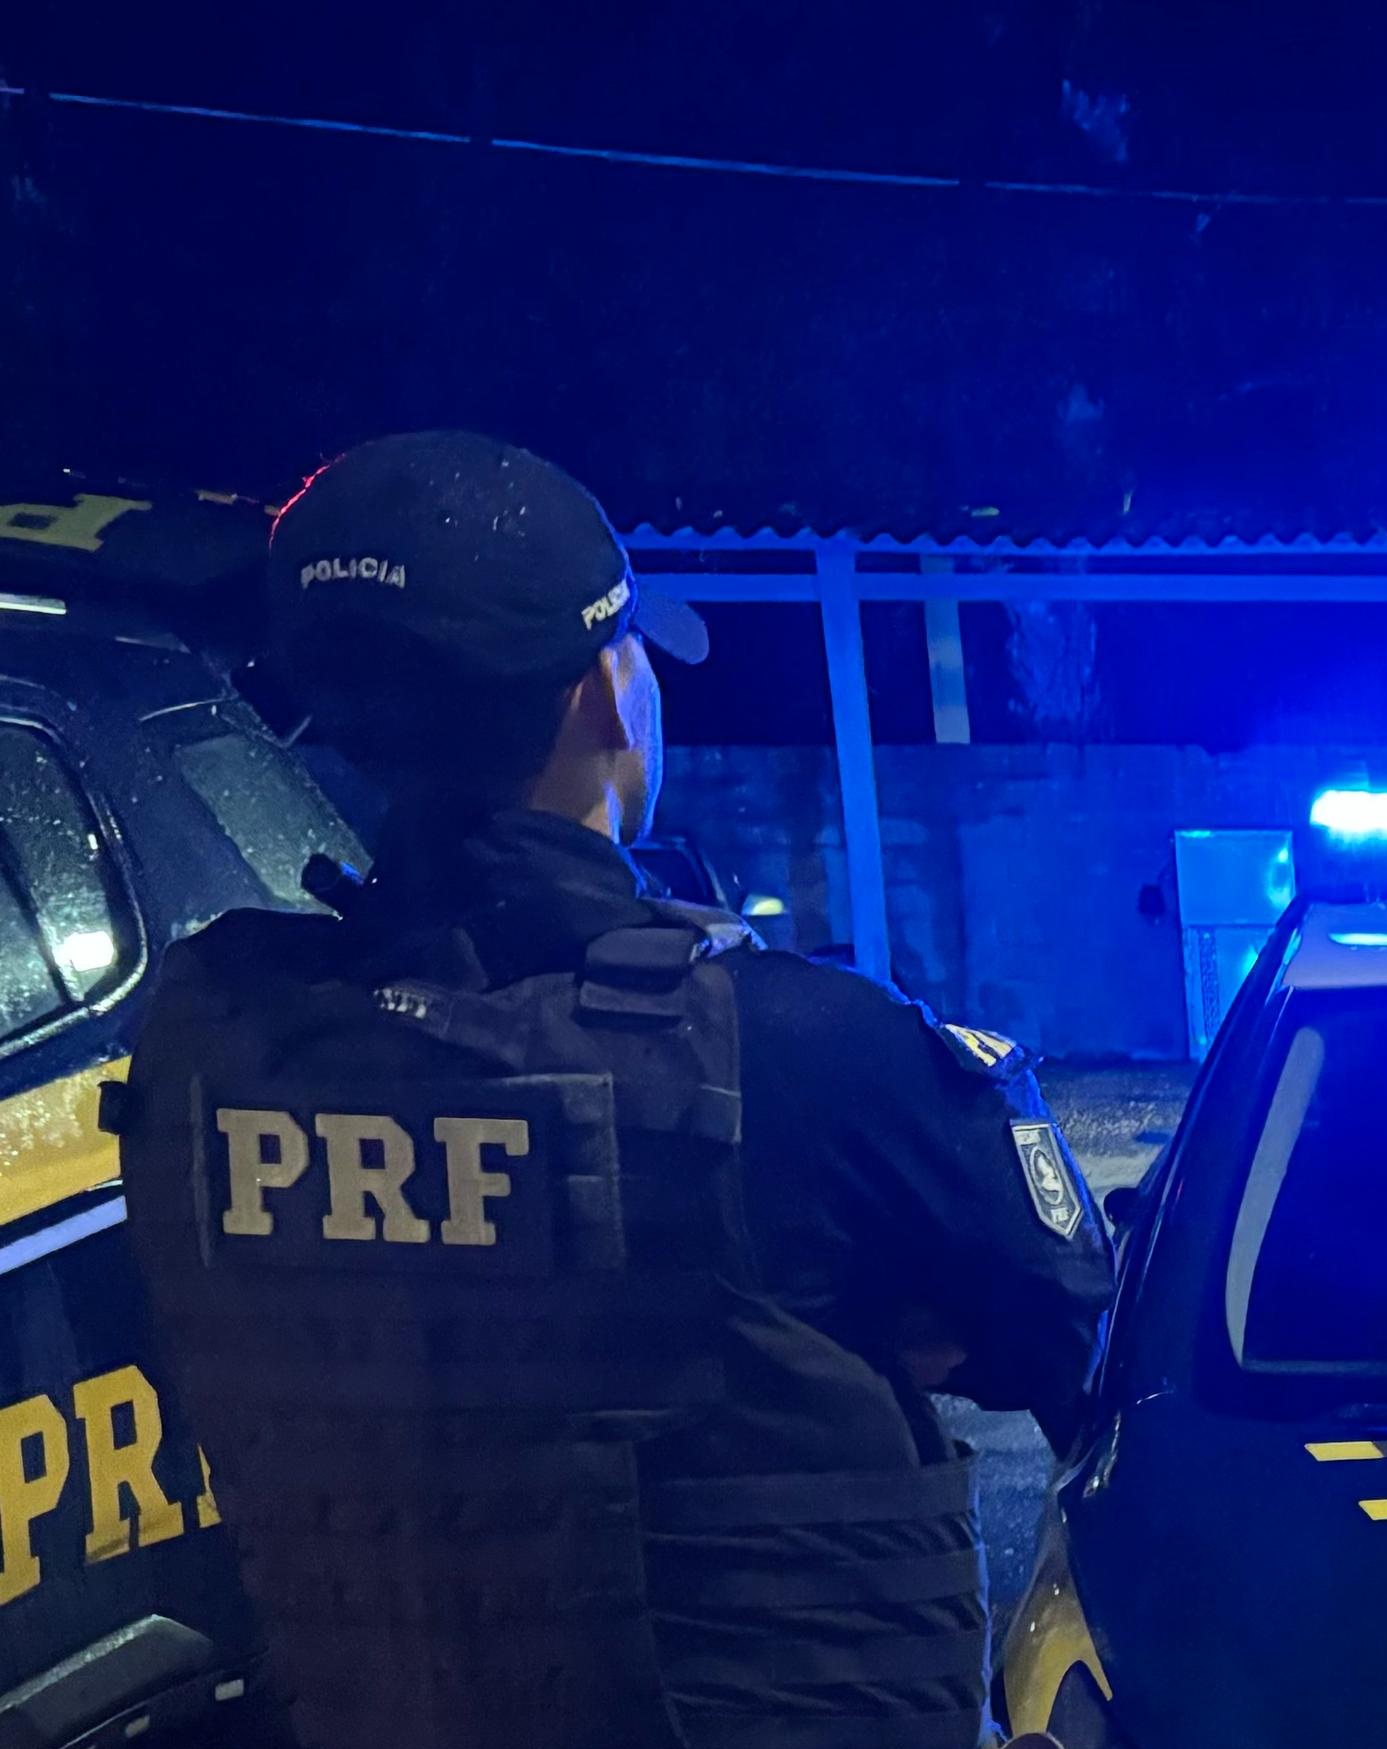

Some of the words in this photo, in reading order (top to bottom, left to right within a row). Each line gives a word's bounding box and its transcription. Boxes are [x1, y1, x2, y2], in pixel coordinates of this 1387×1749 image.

[301, 557, 405, 589] POLICIA
[216, 1107, 529, 1246] PRF
[0, 1365, 221, 1603] PR
